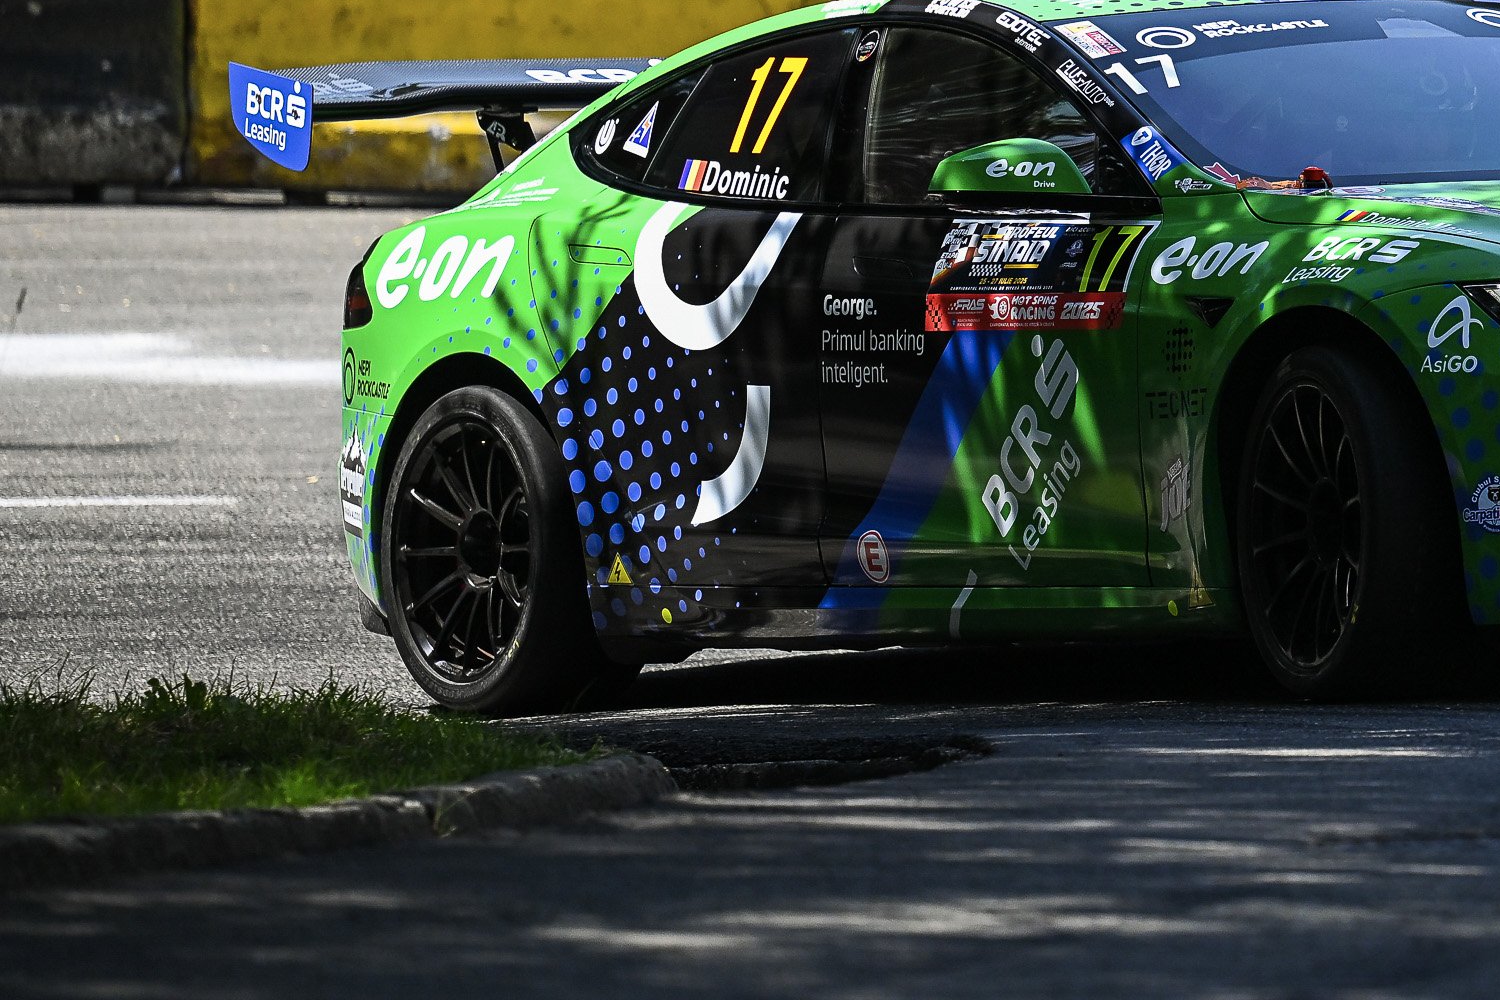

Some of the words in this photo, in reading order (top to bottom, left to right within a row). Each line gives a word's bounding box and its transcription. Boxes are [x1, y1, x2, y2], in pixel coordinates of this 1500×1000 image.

[1192, 19, 1241, 32] NEPI
[1202, 19, 1330, 39] ROCKCASTLE
[525, 68, 641, 84] BCR
[1103, 53, 1181, 95] 17
[246, 82, 284, 122] BCR
[729, 56, 809, 154] 17
[244, 118, 287, 151] Leasing
[1140, 140, 1173, 181] THOR
[701, 160, 790, 199] Dominic
[1033, 180, 1056, 189] Drive
[1358, 212, 1430, 228] Dominic
[1003, 226, 1060, 241] TROFEUL
[972, 240, 1051, 263] SINAIA
[1078, 225, 1145, 292] 17
[1303, 236, 1381, 263] BCR
[1282, 263, 1355, 285] Leasing
[823, 294, 877, 319] George.
[957, 299, 986, 311] FRAS
[1011, 295, 1031, 305] HOT
[1032, 295, 1059, 305] SPINS
[1060, 301, 1105, 320] 2025
[1010, 306, 1055, 321] RACING
[822, 330, 866, 352] Primul
[869, 328, 925, 356] banking
[357, 359, 371, 376] NEPI
[821, 361, 888, 388] inteligent.
[1420, 355, 1478, 374] AsiGO
[357, 379, 391, 400] ROCKCASTLE
[1145, 388, 1208, 420] TECNET
[982, 404, 1052, 538] BCR
[1471, 477, 1492, 503] Clubul
[1008, 439, 1081, 571] Leasing
[864, 541, 884, 572] E
